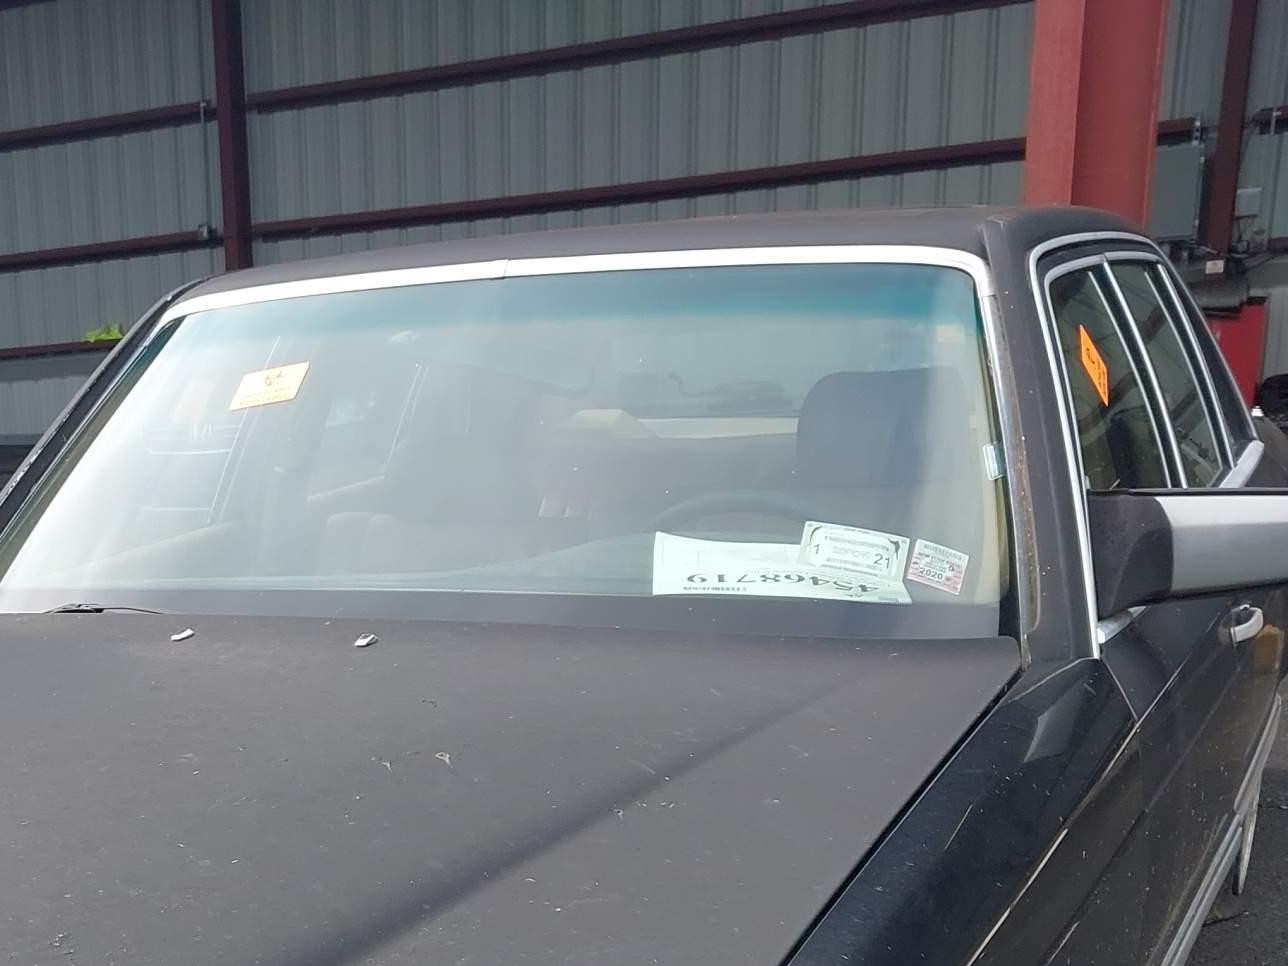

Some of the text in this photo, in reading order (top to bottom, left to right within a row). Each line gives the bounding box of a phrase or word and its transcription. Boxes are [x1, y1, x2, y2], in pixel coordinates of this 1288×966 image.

[813, 543, 820, 555] 1
[873, 552, 891, 569] 21
[686, 573, 880, 593] 45468719
[919, 567, 944, 581] 2020
